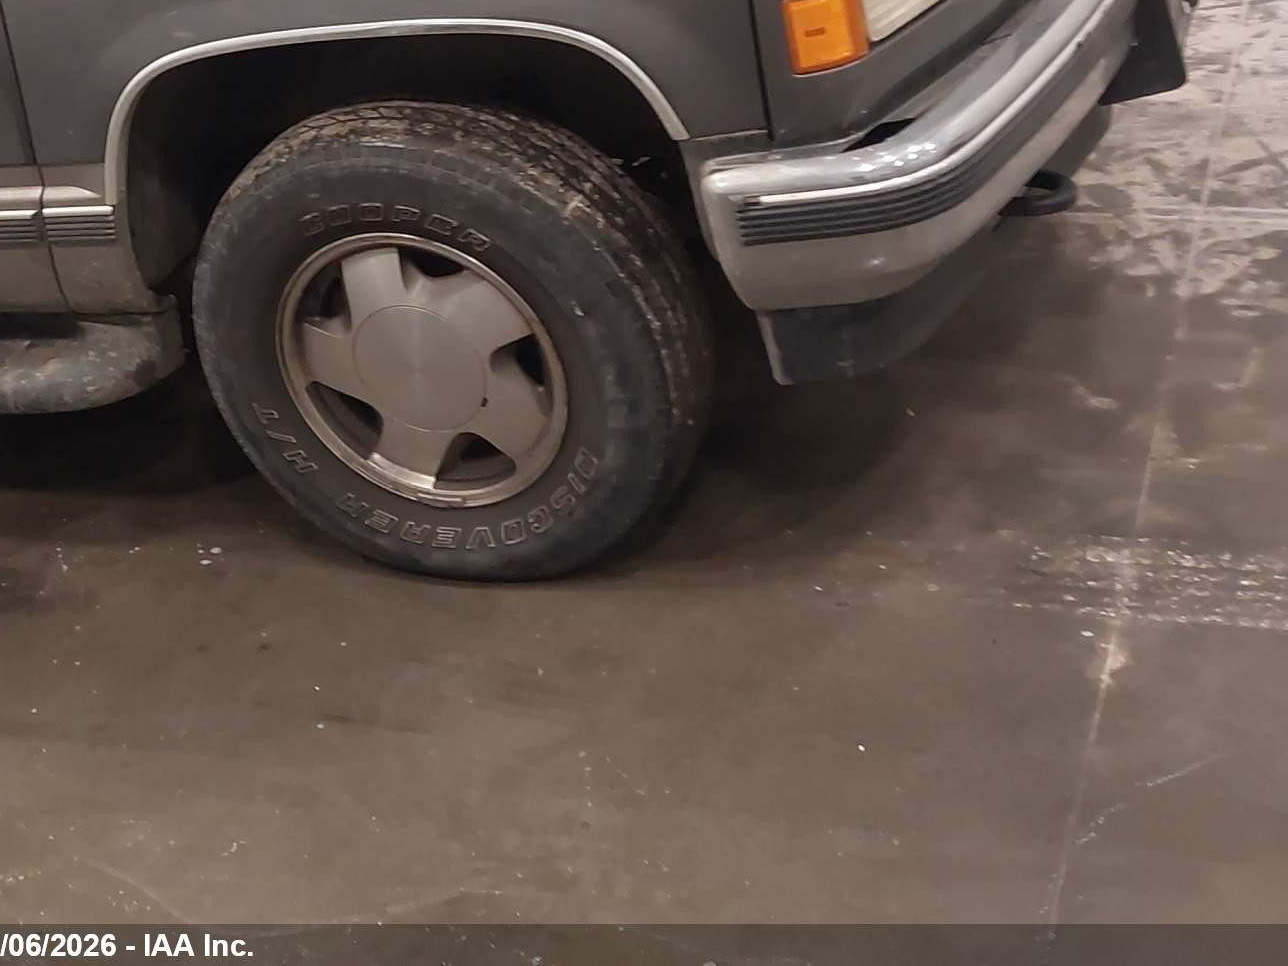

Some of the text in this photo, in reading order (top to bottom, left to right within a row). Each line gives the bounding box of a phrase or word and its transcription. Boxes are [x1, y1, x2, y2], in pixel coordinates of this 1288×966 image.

[298, 201, 493, 253] COOPER
[251, 401, 599, 551] DISCOVERER H/T
